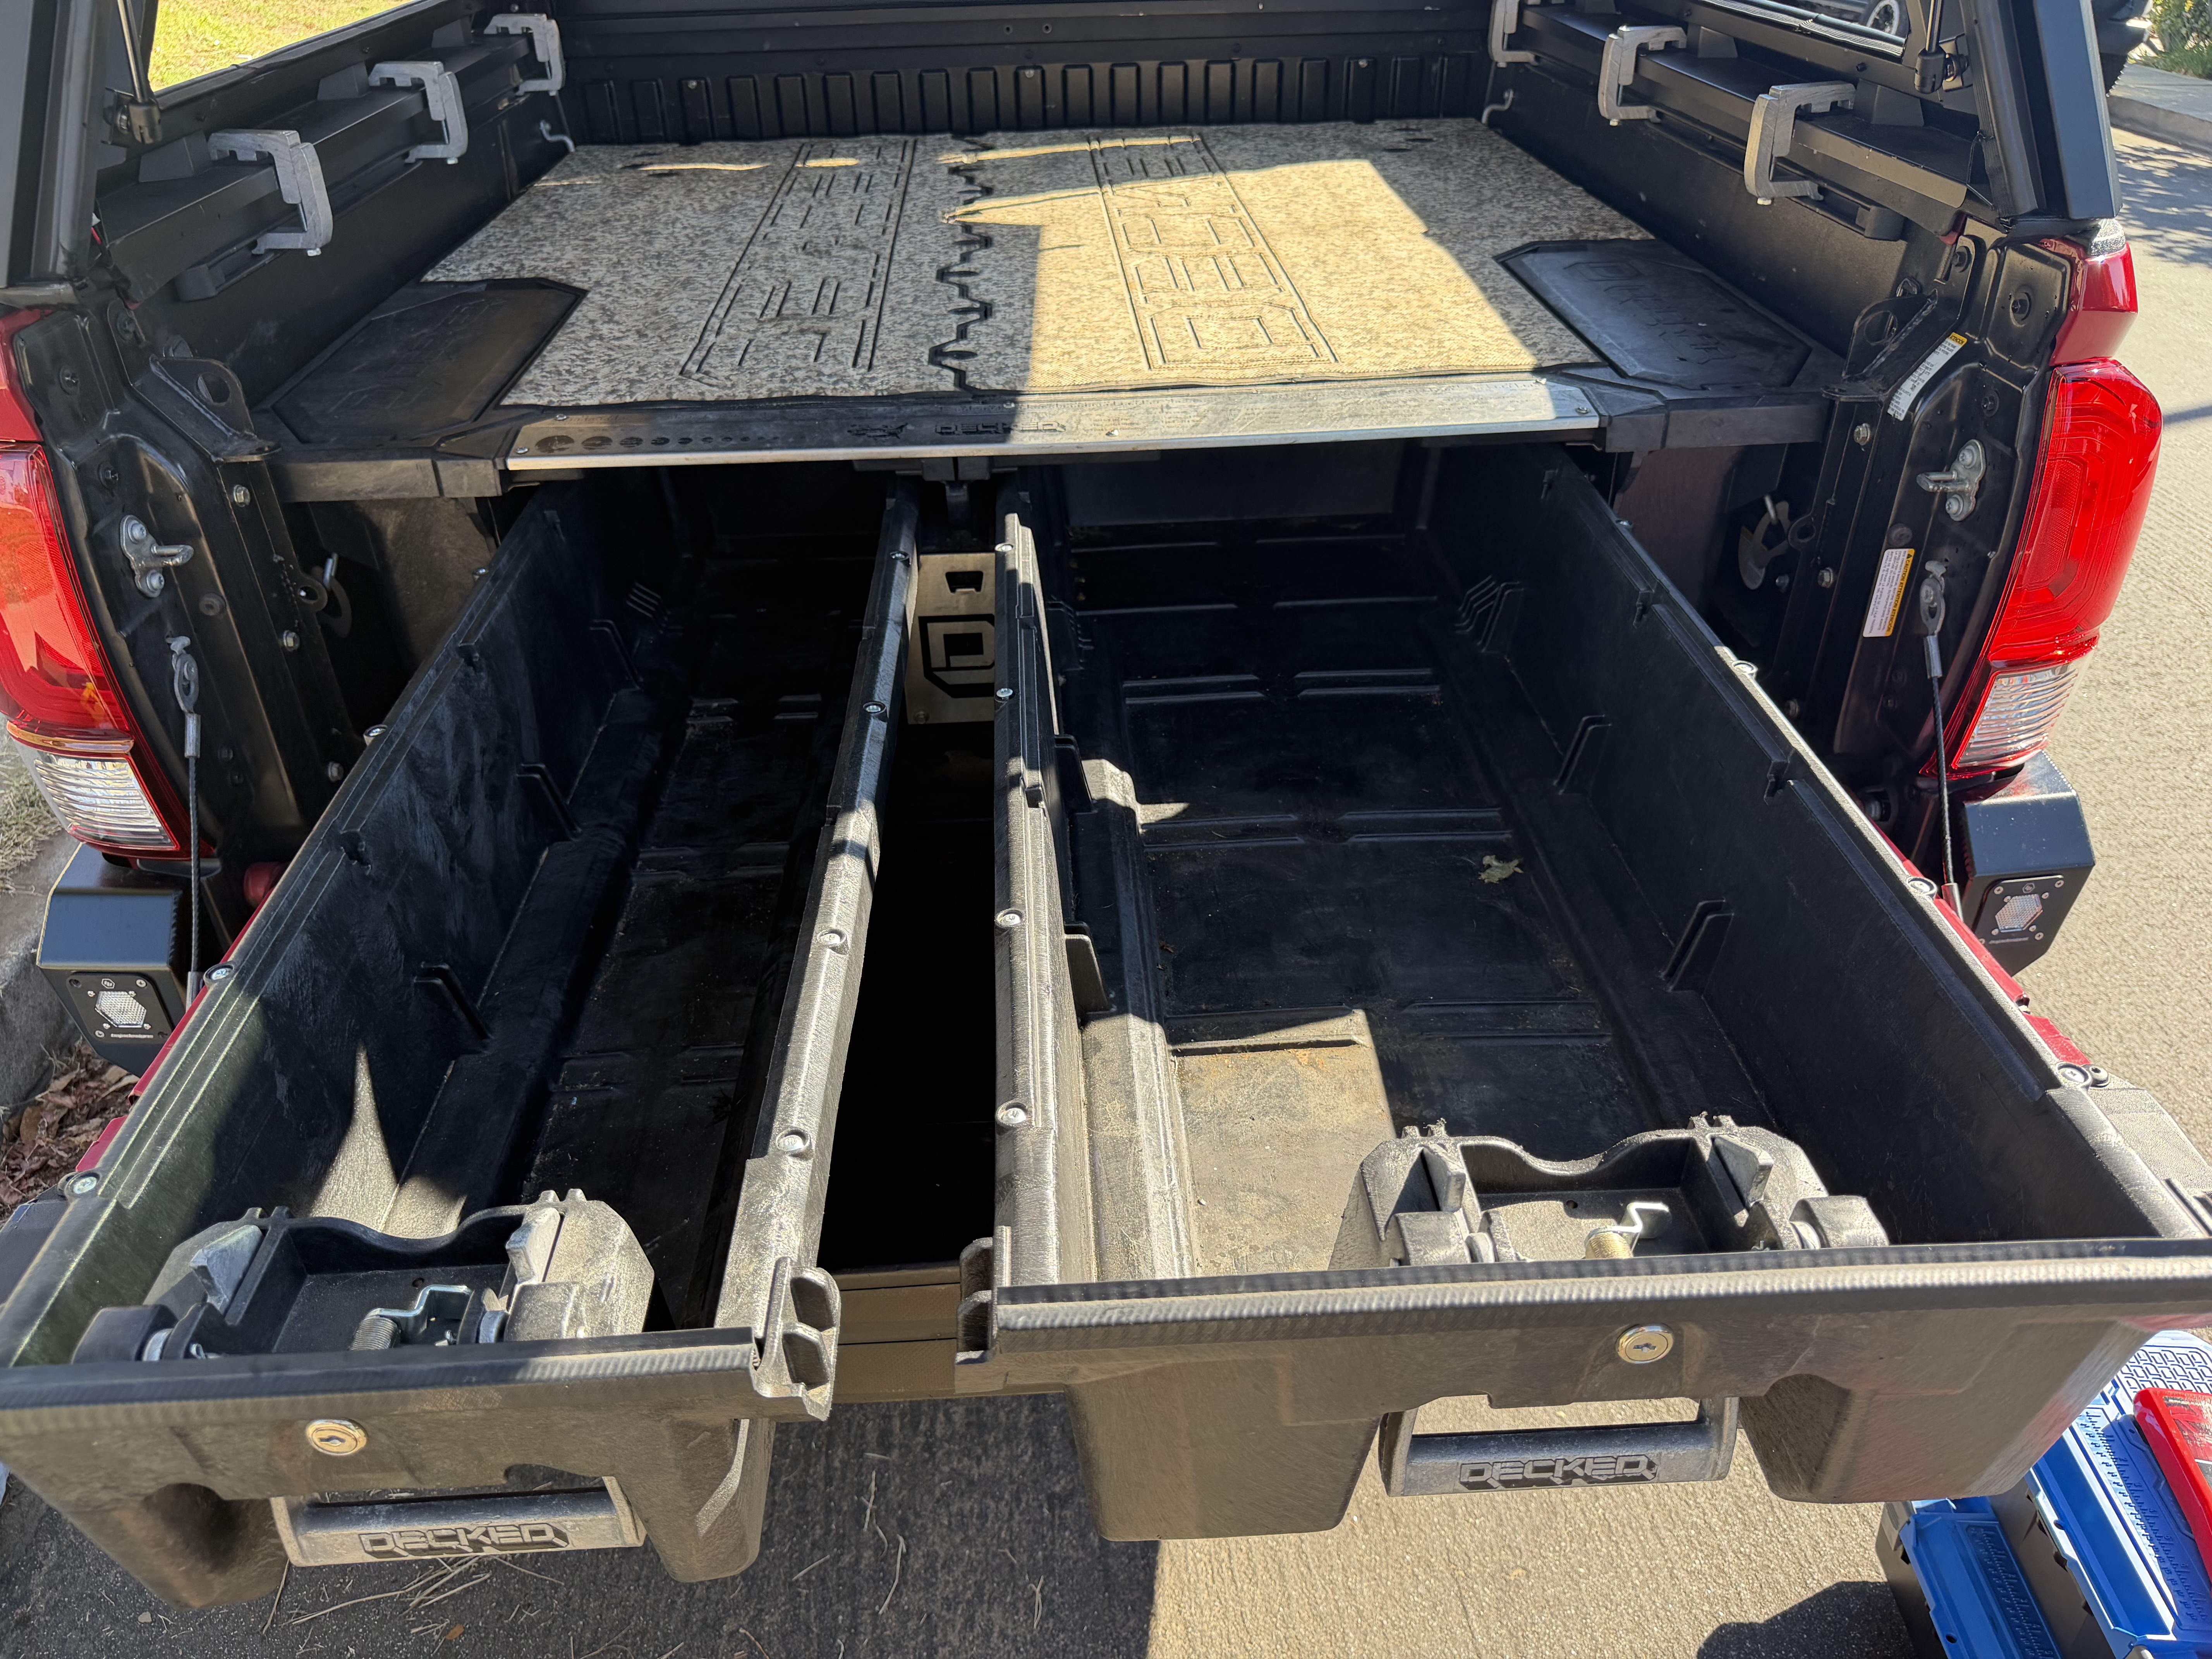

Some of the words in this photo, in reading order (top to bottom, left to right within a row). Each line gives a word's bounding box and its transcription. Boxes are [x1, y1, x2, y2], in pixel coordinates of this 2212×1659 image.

[935, 421, 1066, 435] DECKED
[1900, 560, 1910, 580] CAUTION
[1893, 582, 1904, 608] ATTENTION
[1459, 1454, 1658, 1490] DECKED
[358, 1522, 568, 1558] DECKED
